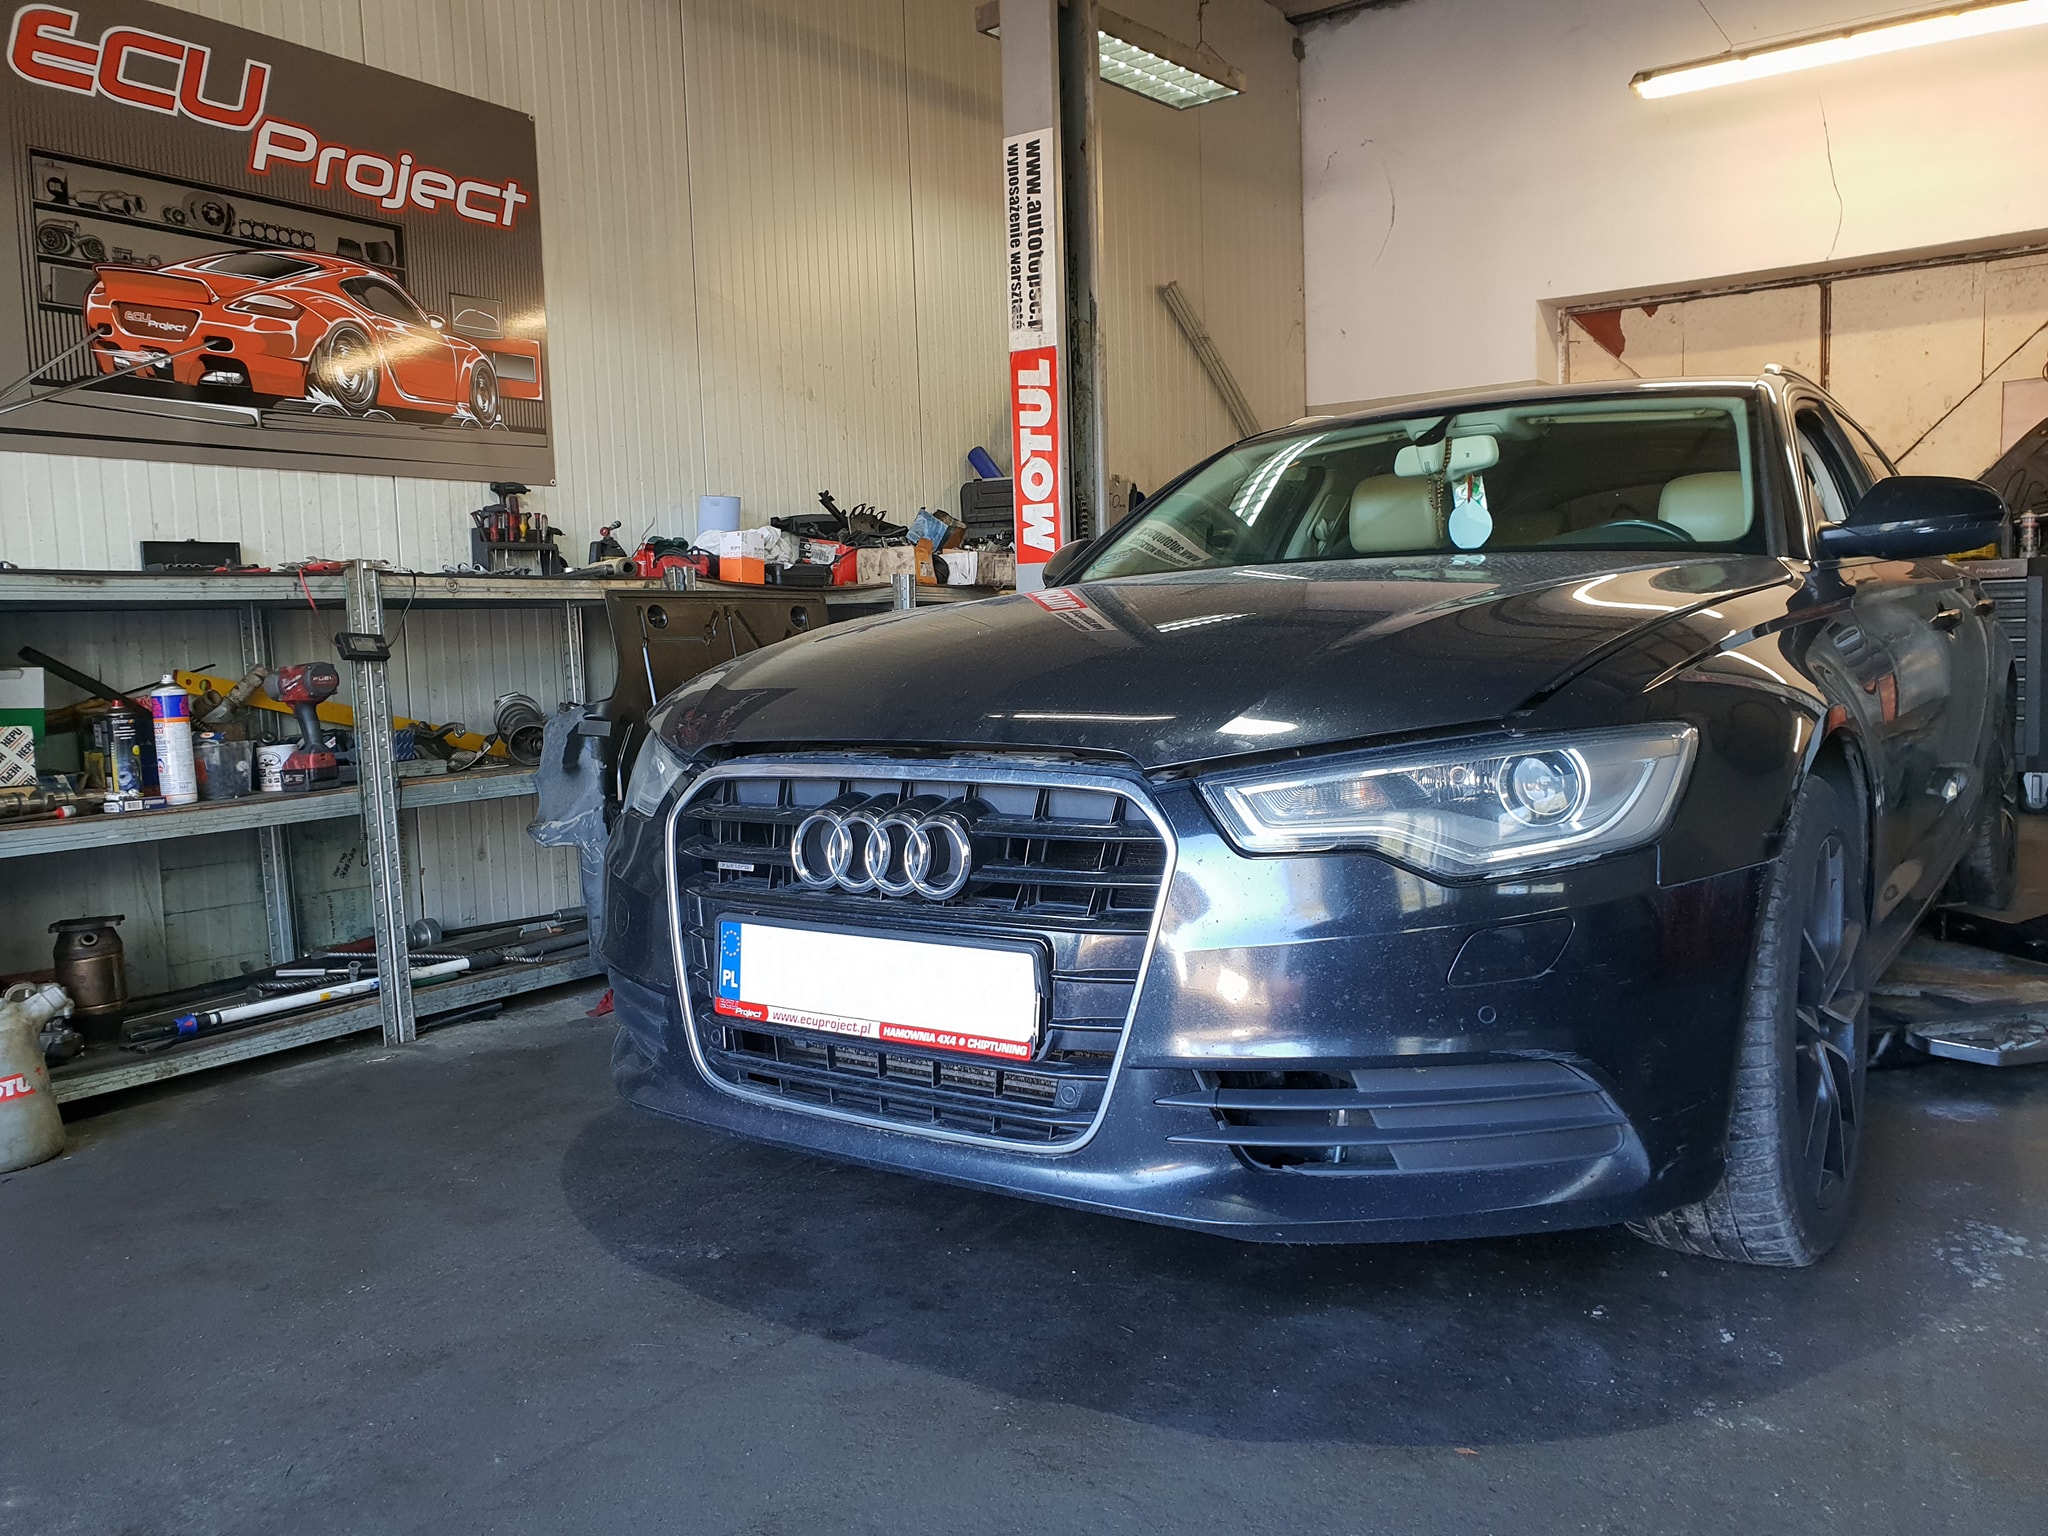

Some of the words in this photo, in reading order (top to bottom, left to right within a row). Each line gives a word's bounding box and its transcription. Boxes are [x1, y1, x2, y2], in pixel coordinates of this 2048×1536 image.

[7, 4, 272, 131] ECU
[251, 119, 528, 227] Project
[124, 311, 151, 323] ECU
[148, 320, 188, 332] Project
[1018, 358, 1056, 552] MOTUL
[1, 728, 23, 747] HEPU
[722, 969, 739, 988] PL
[735, 1007, 763, 1019] Project
[772, 1010, 872, 1037] www.ecuproject.pl
[883, 1026, 936, 1044] HAMOWNIA
[967, 1038, 1028, 1056] CHIPTUNING
